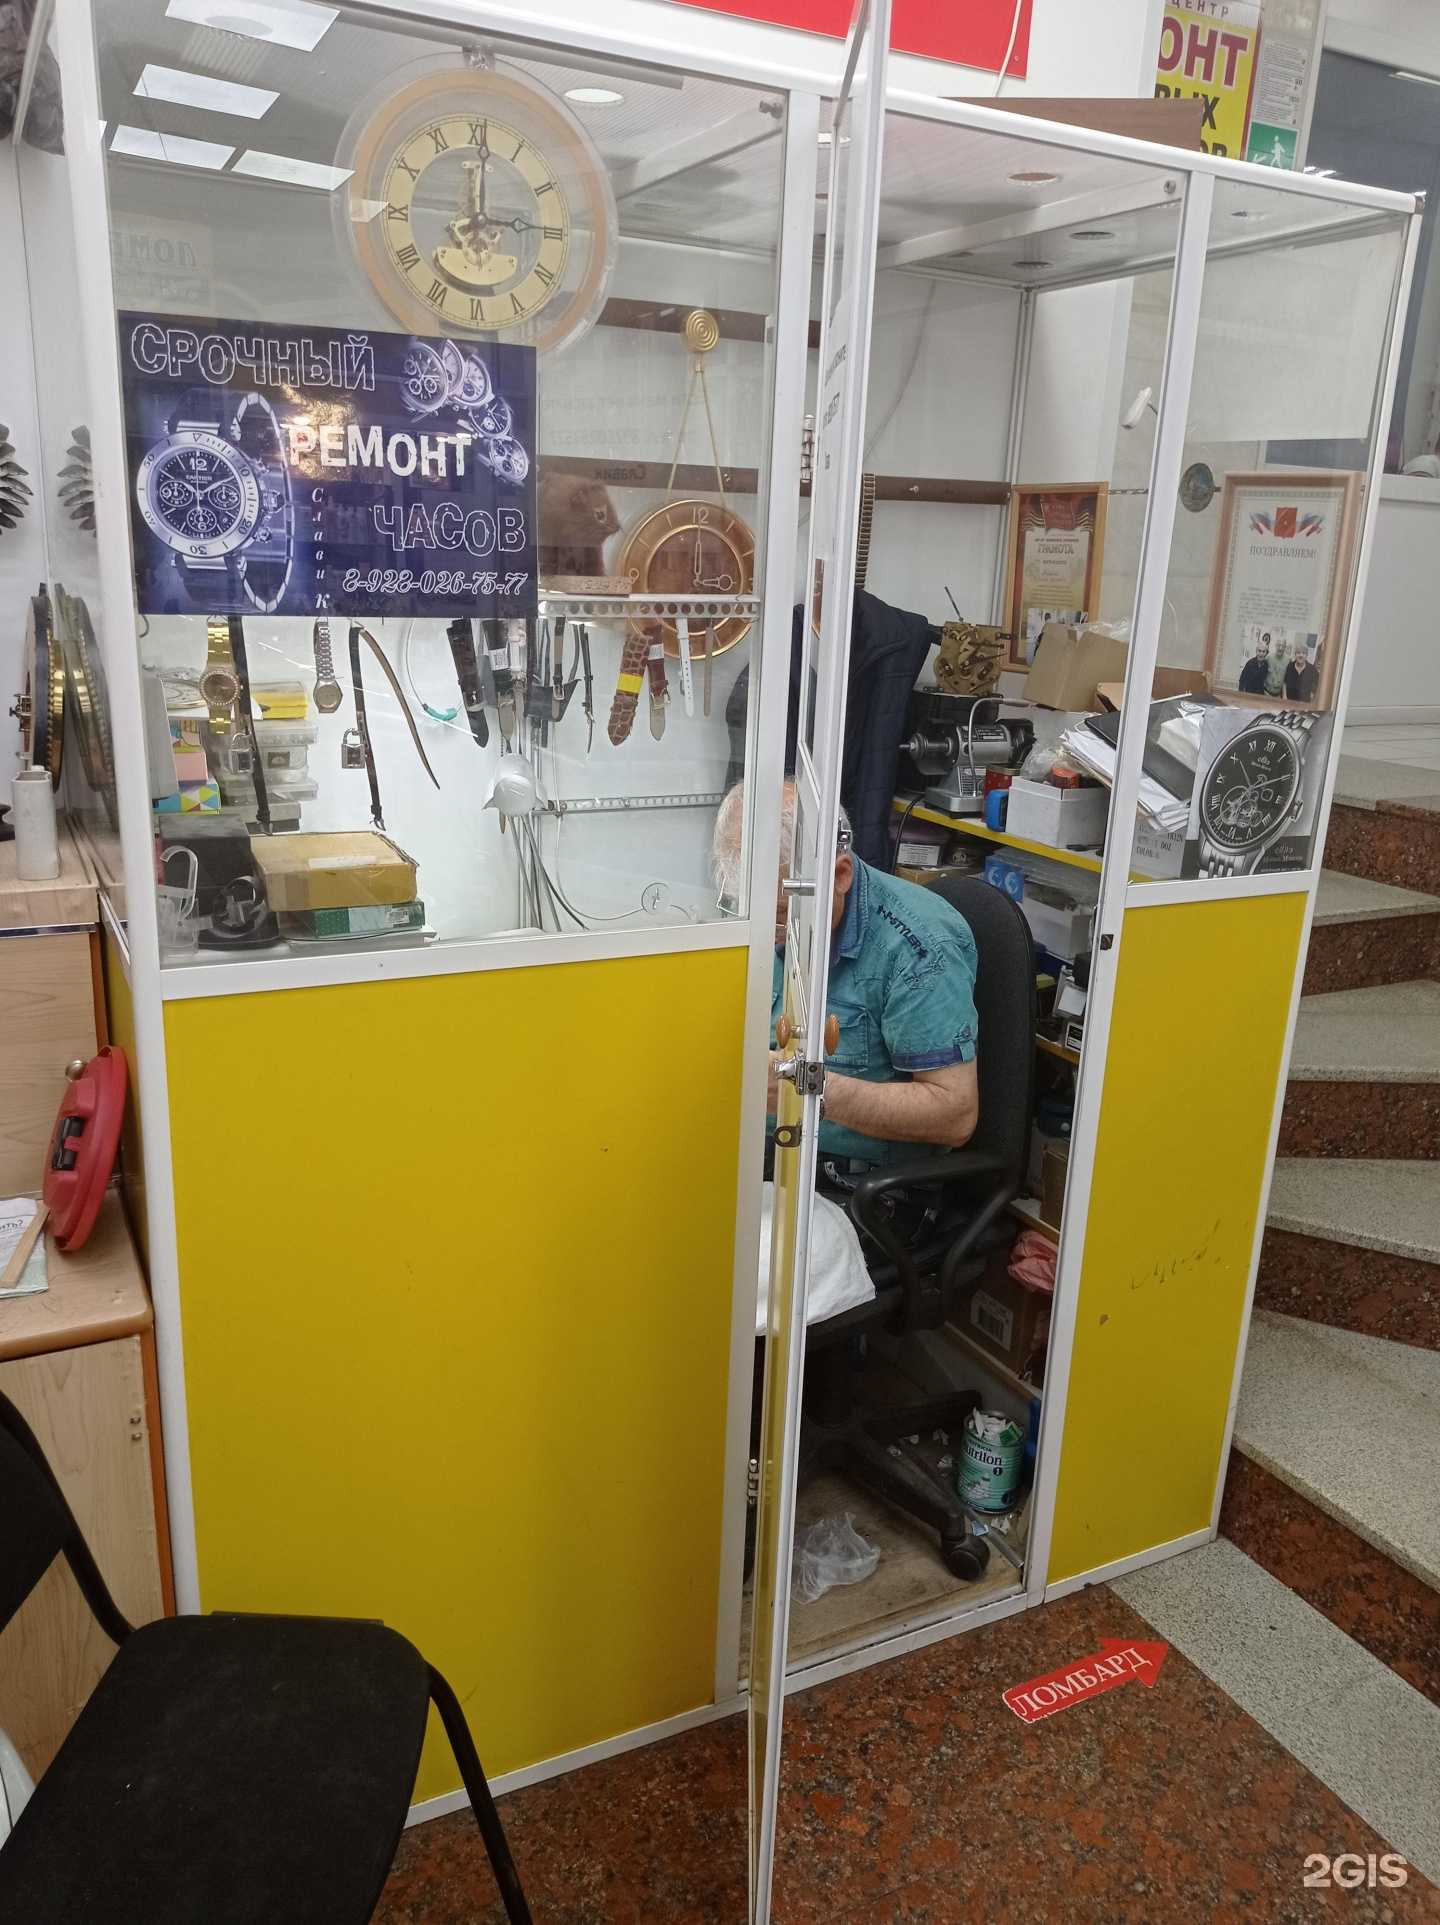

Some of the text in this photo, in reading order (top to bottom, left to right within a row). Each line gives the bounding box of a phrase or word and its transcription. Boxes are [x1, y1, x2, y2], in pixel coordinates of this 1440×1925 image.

[132, 323, 376, 392] СРОЧНЫЙ
[288, 424, 472, 477] РЕМОНТ
[373, 502, 526, 557] ЧАСОВ
[692, 506, 709, 524] 12
[342, 568, 529, 597] 8-928-026-75-77
[1012, 1647, 1153, 1717] ЛОМБАРД
